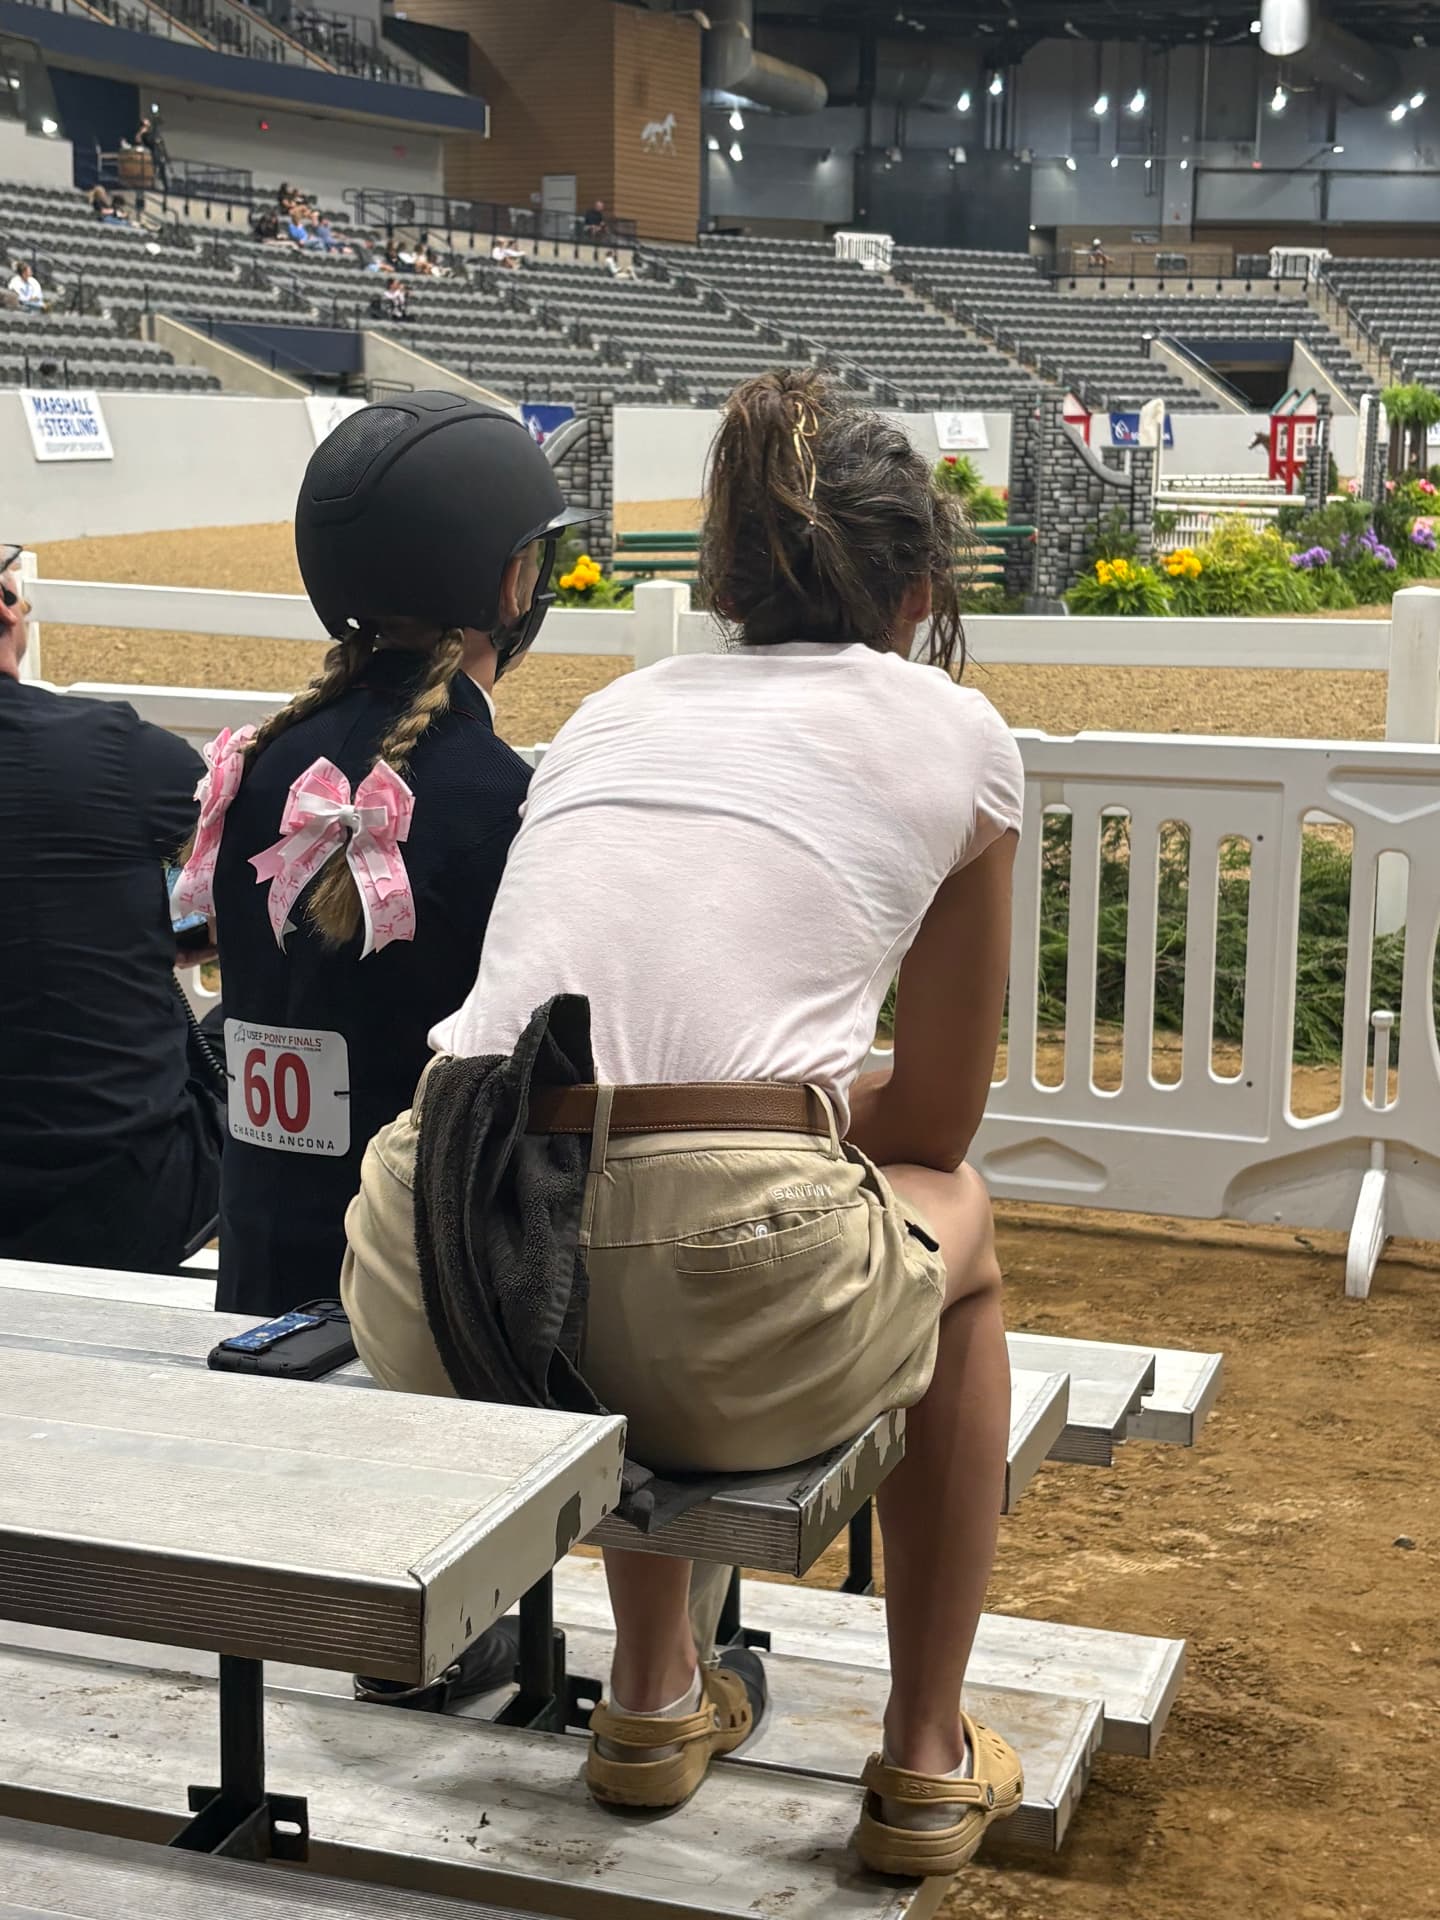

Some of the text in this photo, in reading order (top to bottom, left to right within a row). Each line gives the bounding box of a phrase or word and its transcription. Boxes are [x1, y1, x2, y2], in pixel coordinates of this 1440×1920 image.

[32, 396, 93, 415] MARSHALL
[264, 1033, 287, 1044] PONY
[288, 1036, 322, 1048] FINALS
[243, 1048, 311, 1134] 60
[233, 1124, 335, 1151] CHARLES ANCONA
